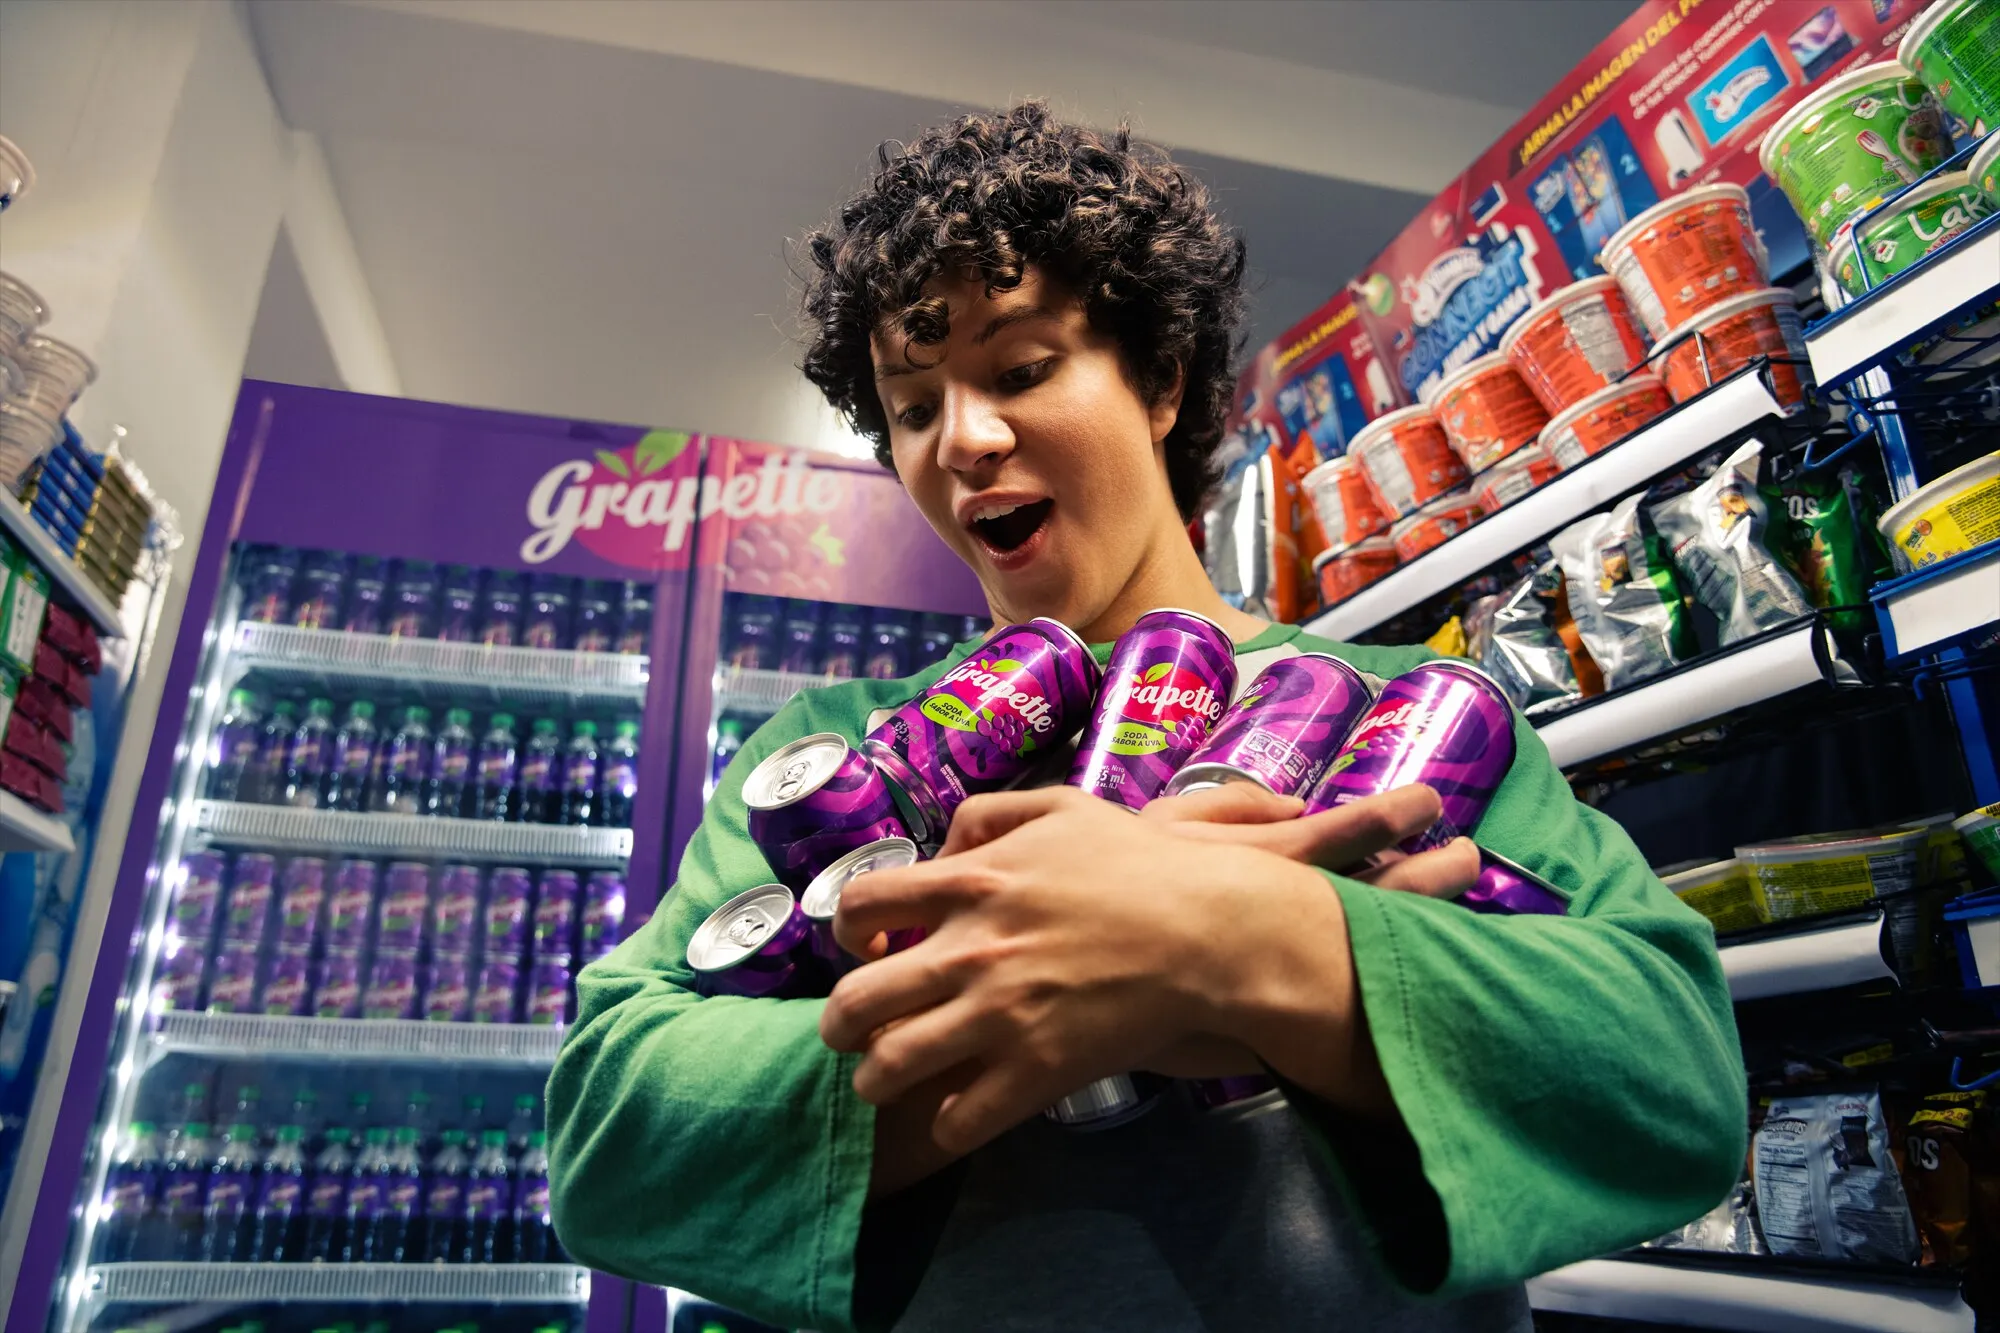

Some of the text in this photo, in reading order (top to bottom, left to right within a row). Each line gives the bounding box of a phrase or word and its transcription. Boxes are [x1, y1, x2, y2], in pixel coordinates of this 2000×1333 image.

[1562, 94, 1585, 122] LA
[1581, 37, 1647, 104] IMAGEN
[1645, 10, 1682, 47] DEL
[1620, 154, 1639, 176] 2
[520, 453, 843, 565] Grapette
[933, 661, 1053, 733] Grapette
[941, 701, 963, 717] SODA
[1097, 682, 1221, 724] Grapette
[929, 702, 951, 720] SABOR
[955, 716, 971, 728] UVA
[1111, 736, 1137, 747] SABOR
[1145, 739, 1161, 747] UVA
[1123, 731, 1148, 740] SODA
[1110, 772, 1126, 785] mL
